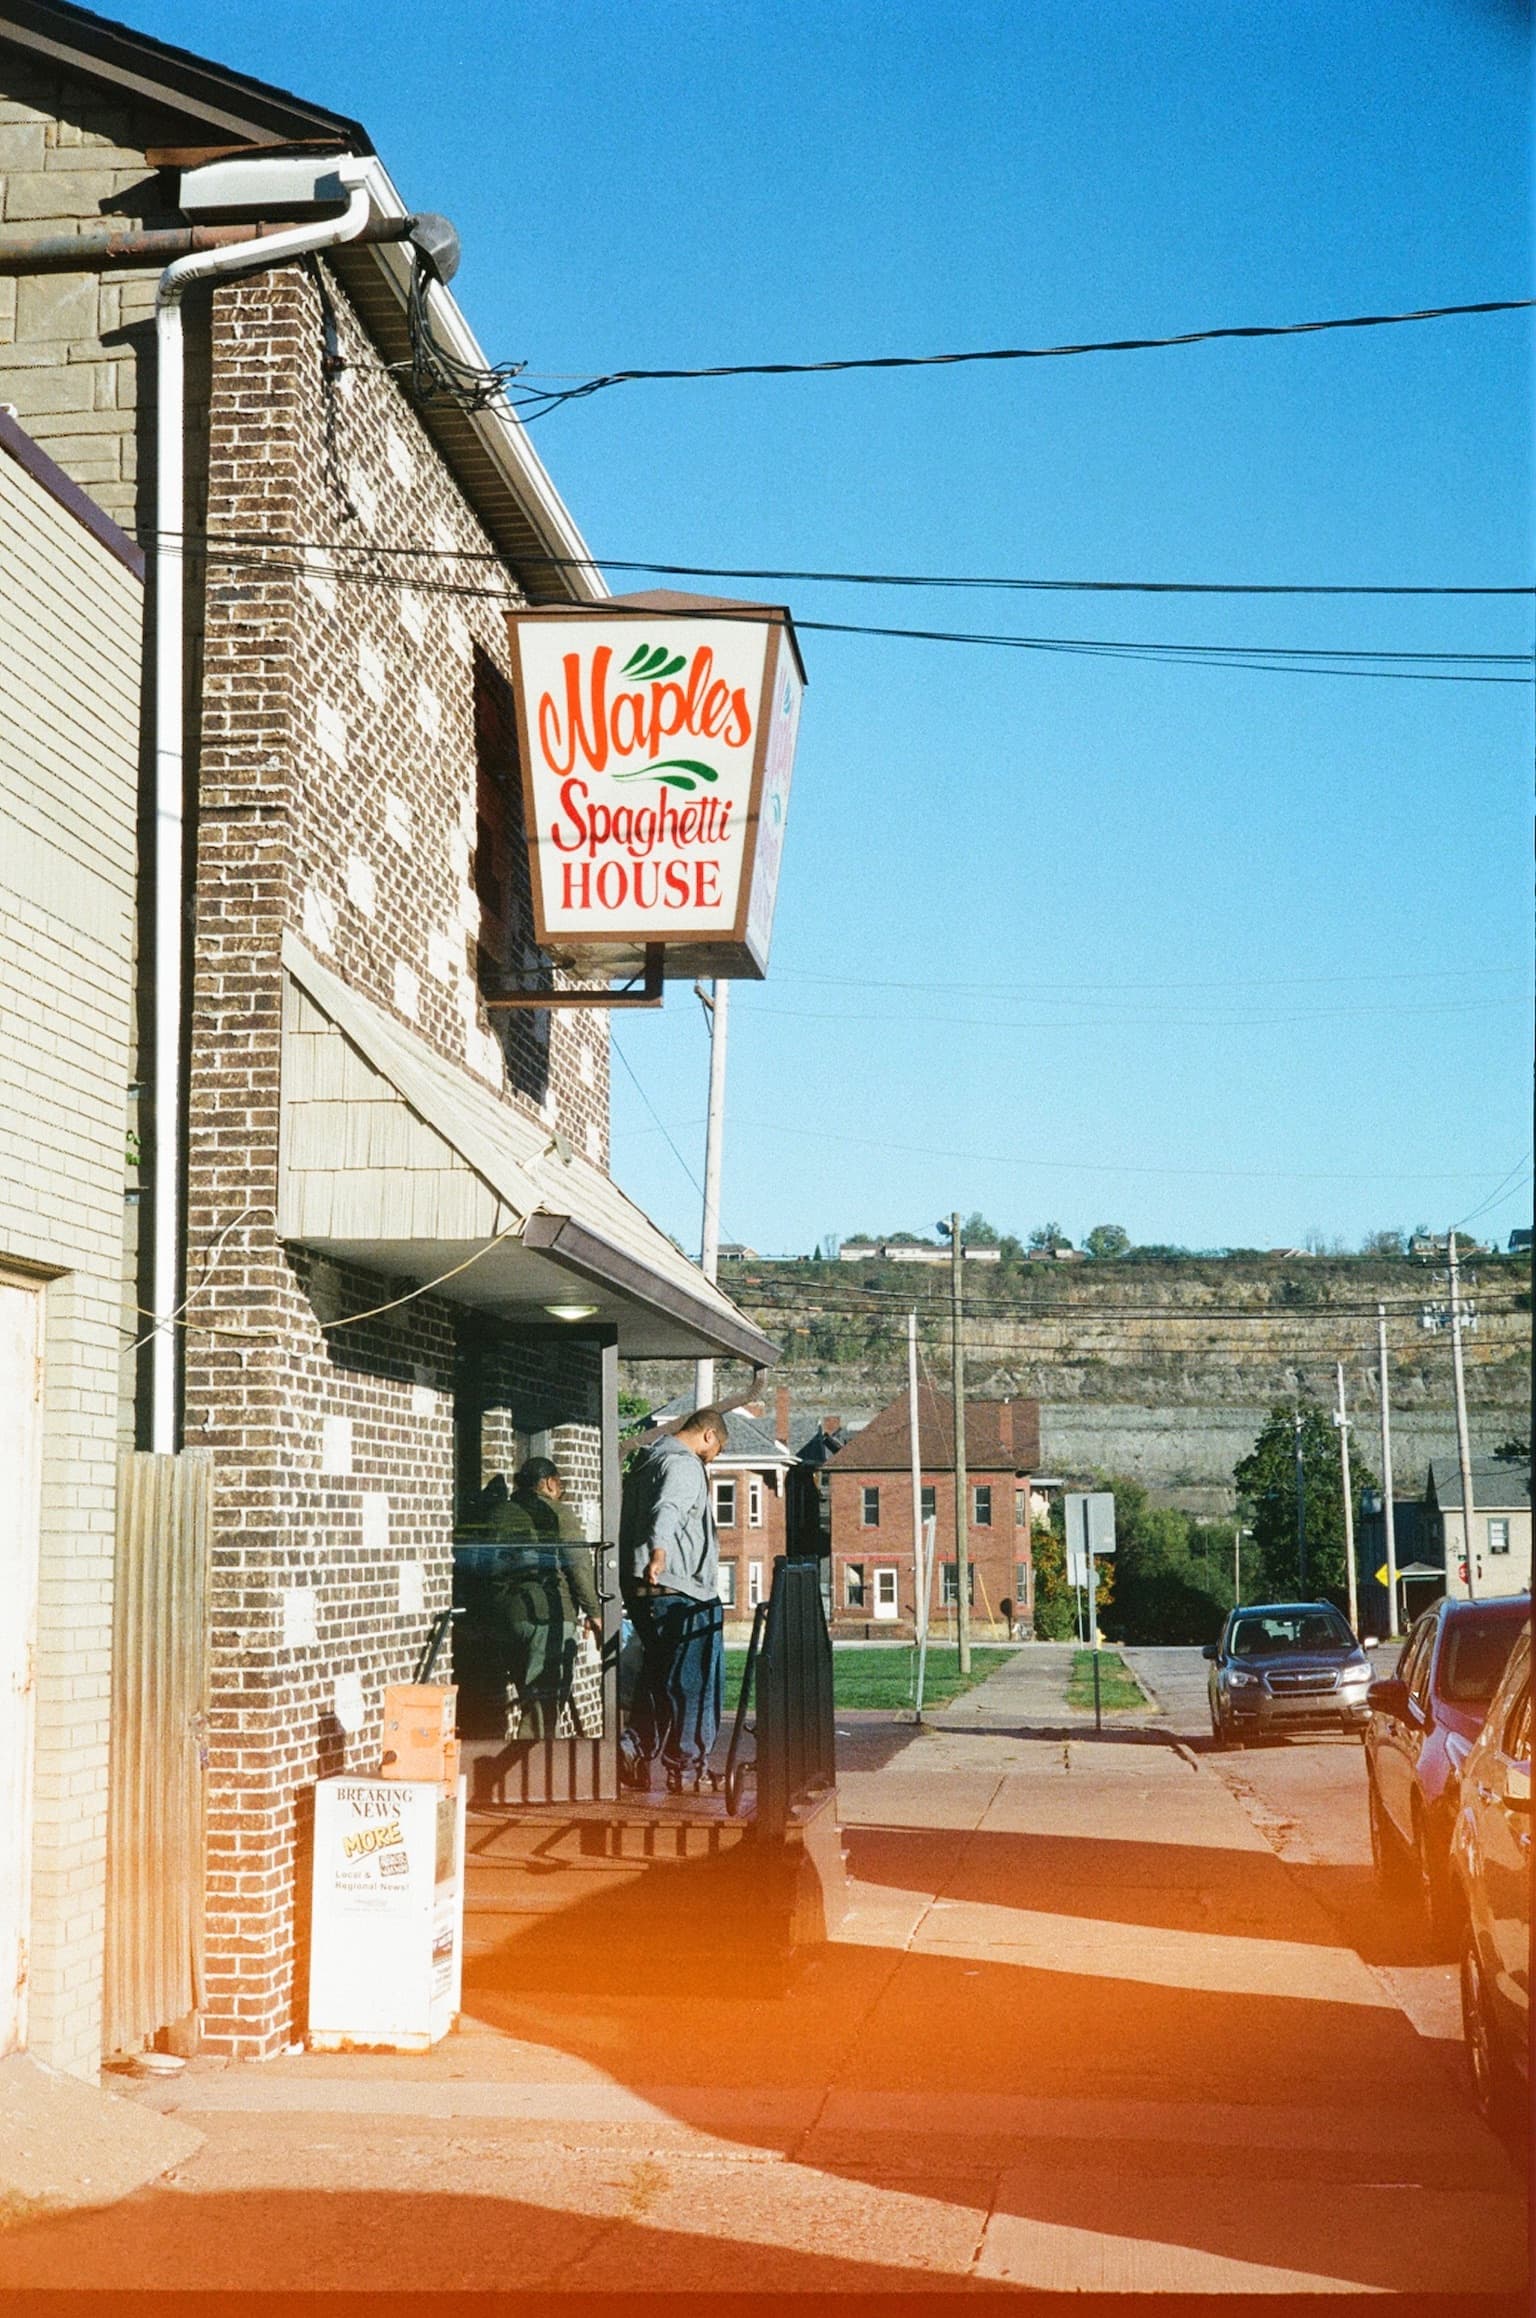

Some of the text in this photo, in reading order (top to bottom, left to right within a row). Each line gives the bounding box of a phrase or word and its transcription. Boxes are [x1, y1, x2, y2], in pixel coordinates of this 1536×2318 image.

[540, 646, 752, 776] Naples
[551, 778, 733, 858] Spaghetti
[561, 860, 722, 910] HOUSE
[337, 1787, 412, 1802] BREAKING
[352, 1802, 401, 1817] NEWS
[343, 1822, 403, 1858] MORE
[335, 1870, 362, 1879] Local
[335, 1881, 377, 1892] Regional
